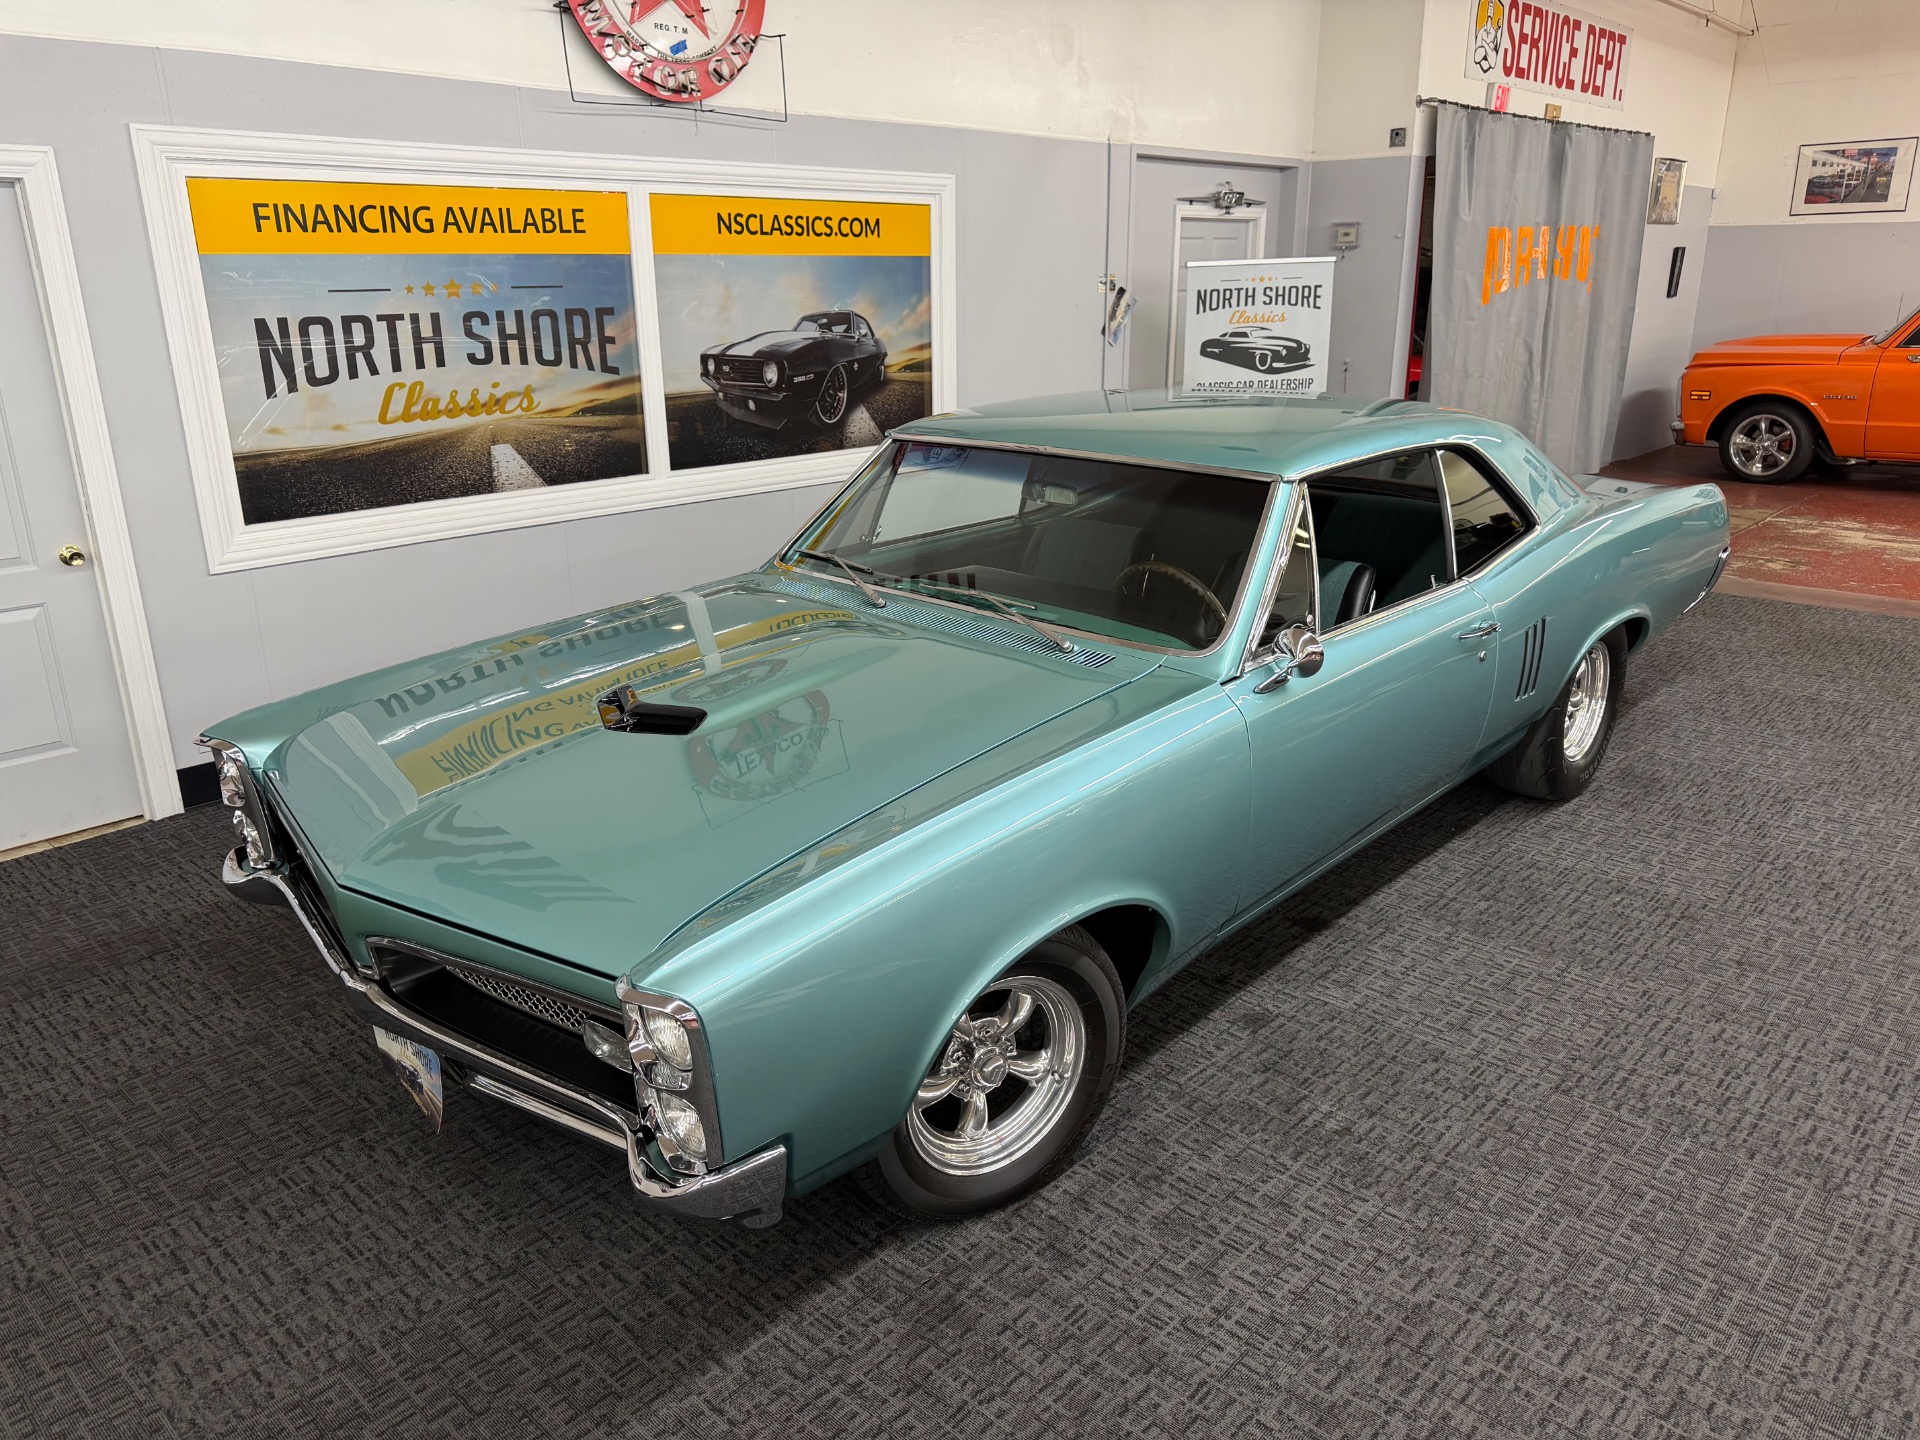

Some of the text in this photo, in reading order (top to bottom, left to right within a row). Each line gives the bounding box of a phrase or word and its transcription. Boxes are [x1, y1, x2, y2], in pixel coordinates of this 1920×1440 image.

[626, 30, 644, 48] MAD
[654, 22, 672, 32] REG.
[1502, 0, 1627, 102] SERVICE DEPT.
[252, 202, 587, 235] FINANCING AVAILABLE
[716, 212, 881, 239] NSCLASSICS.COM
[1196, 284, 1323, 315] NORTH SHORE
[1228, 310, 1288, 325] Classics
[253, 306, 620, 400] NORTH SHORE
[1257, 377, 1314, 390] DEALERSHIP
[377, 380, 541, 426] Classics
